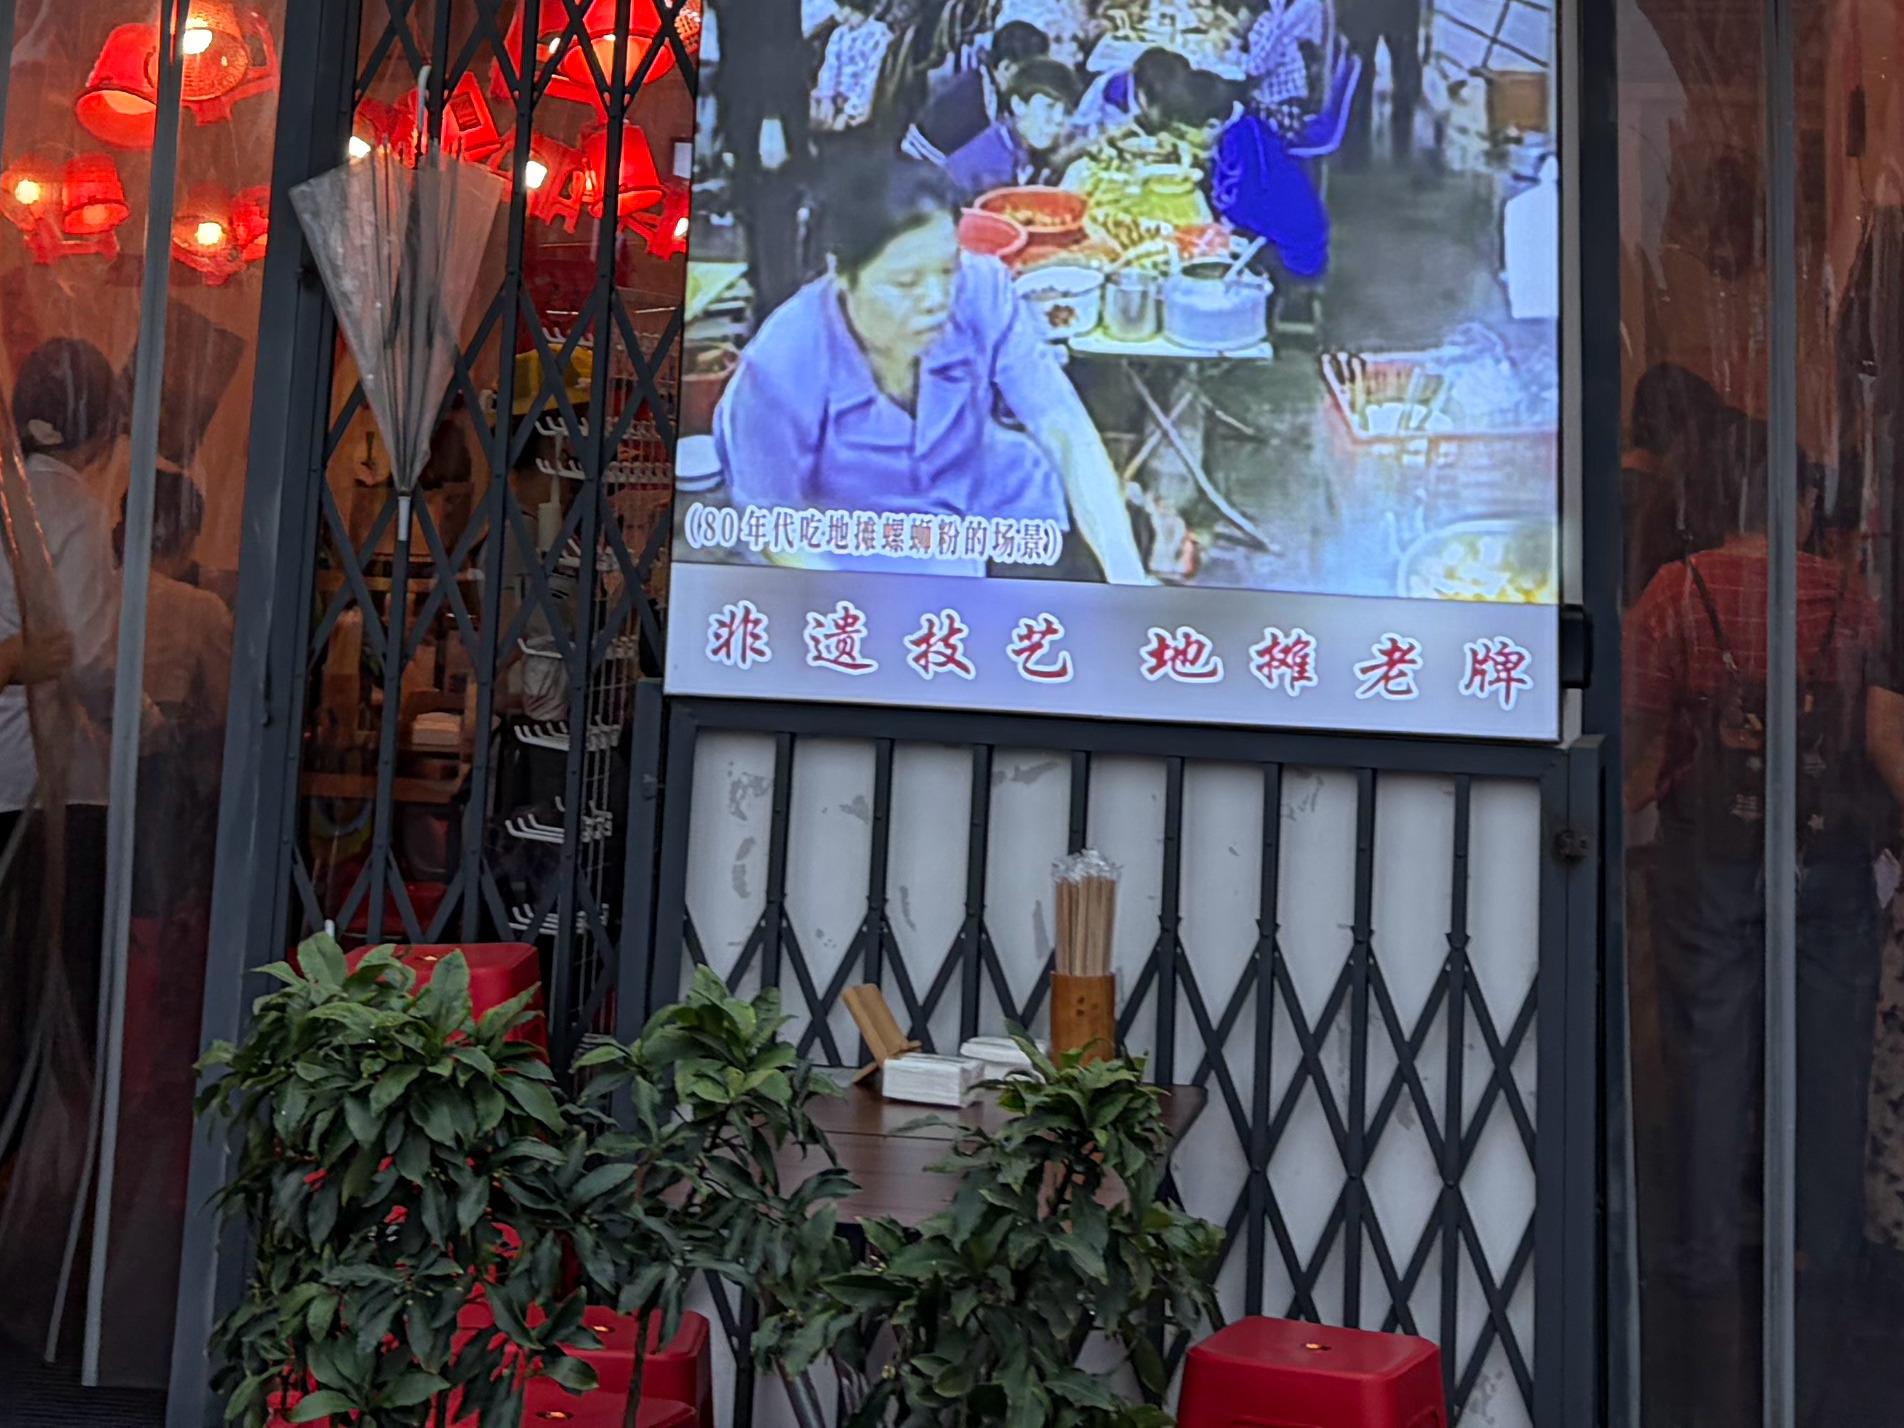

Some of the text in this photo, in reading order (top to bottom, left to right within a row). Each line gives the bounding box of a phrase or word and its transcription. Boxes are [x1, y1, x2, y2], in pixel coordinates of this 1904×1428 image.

[707, 600, 1534, 710] 非遗技艺 地摊老牌
